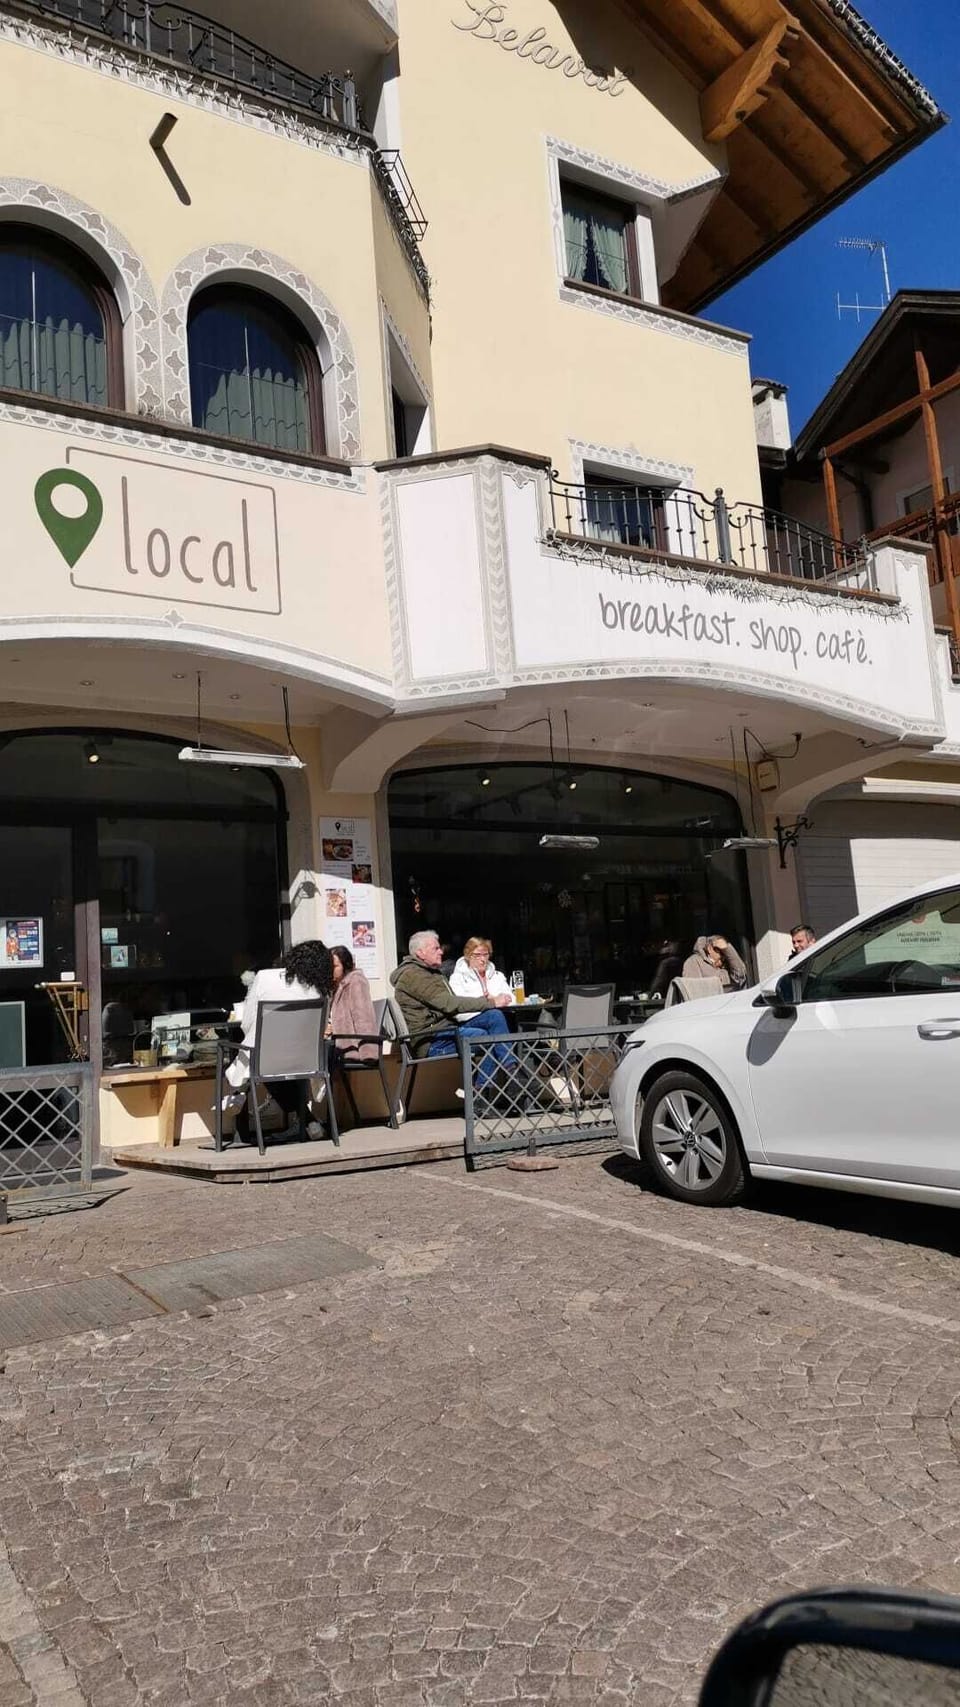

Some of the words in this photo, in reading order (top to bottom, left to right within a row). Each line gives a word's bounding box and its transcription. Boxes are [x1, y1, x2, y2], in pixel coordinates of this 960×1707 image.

[121, 475, 258, 593] local
[598, 592, 741, 648] breakfast.
[749, 617, 808, 671] shop.
